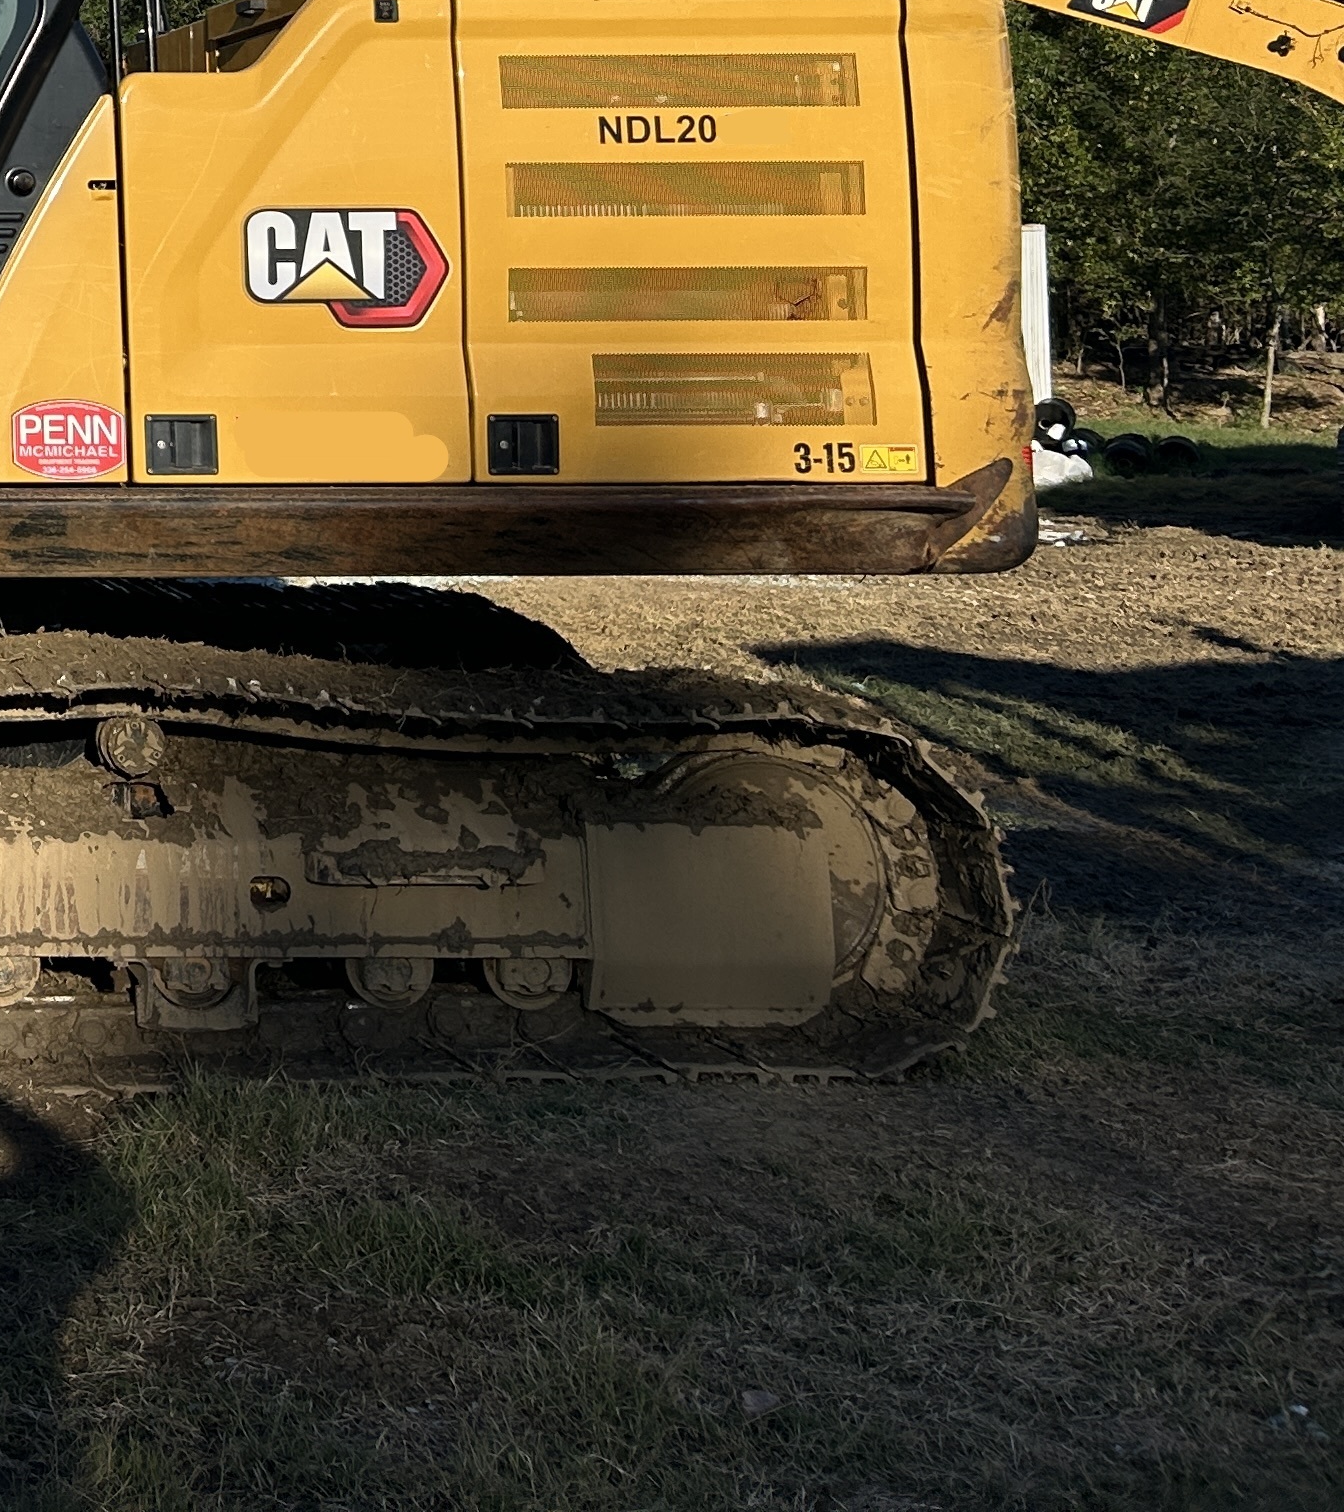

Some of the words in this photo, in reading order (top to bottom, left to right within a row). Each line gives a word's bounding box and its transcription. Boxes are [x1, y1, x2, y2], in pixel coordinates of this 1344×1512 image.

[598, 114, 717, 144] NDL20
[247, 210, 397, 300] CAT
[19, 414, 118, 445] PENN
[19, 445, 118, 458] MCMICHAEL
[793, 442, 855, 474] 3-15
